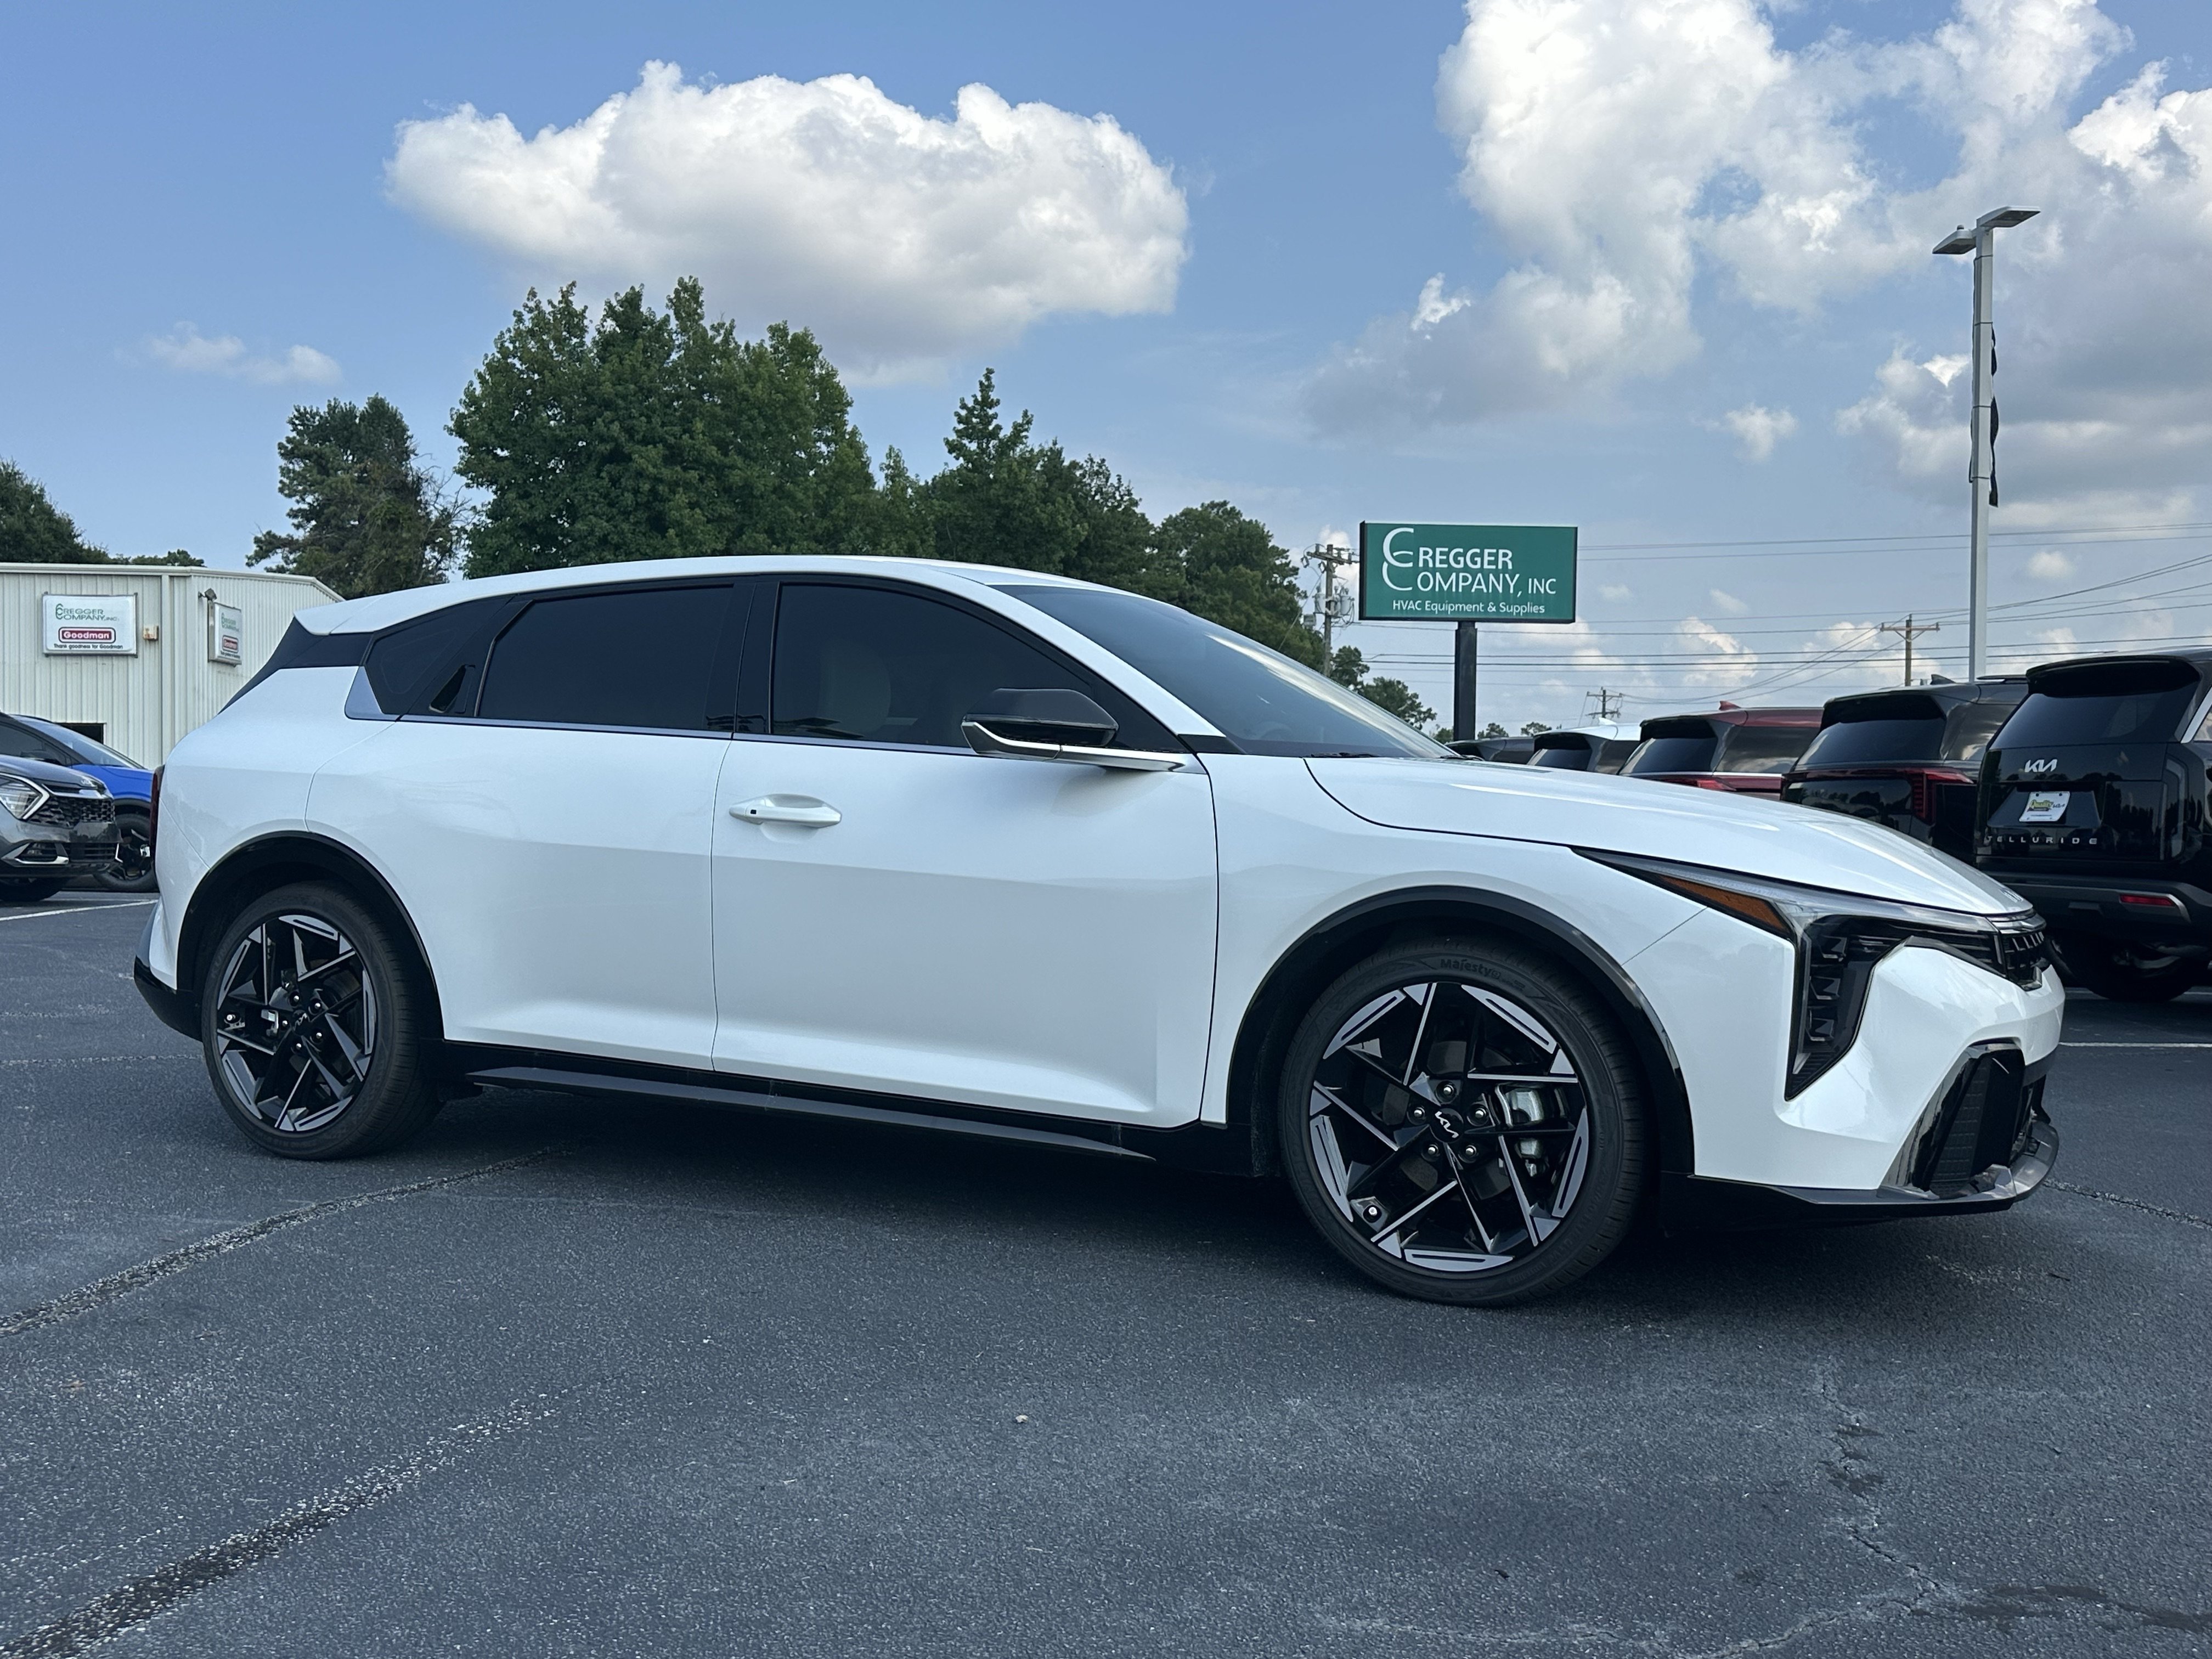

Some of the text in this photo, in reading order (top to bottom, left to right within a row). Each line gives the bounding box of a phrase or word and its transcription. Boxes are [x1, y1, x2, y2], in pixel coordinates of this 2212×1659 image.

[1382, 527, 1513, 569] CREGGER
[1528, 578, 1556, 595] INC
[55, 603, 104, 615] CREGGER
[1392, 600, 1545, 616] HVAC Equipment & Supplies
[1985, 836, 2097, 845] TELLURIDE
